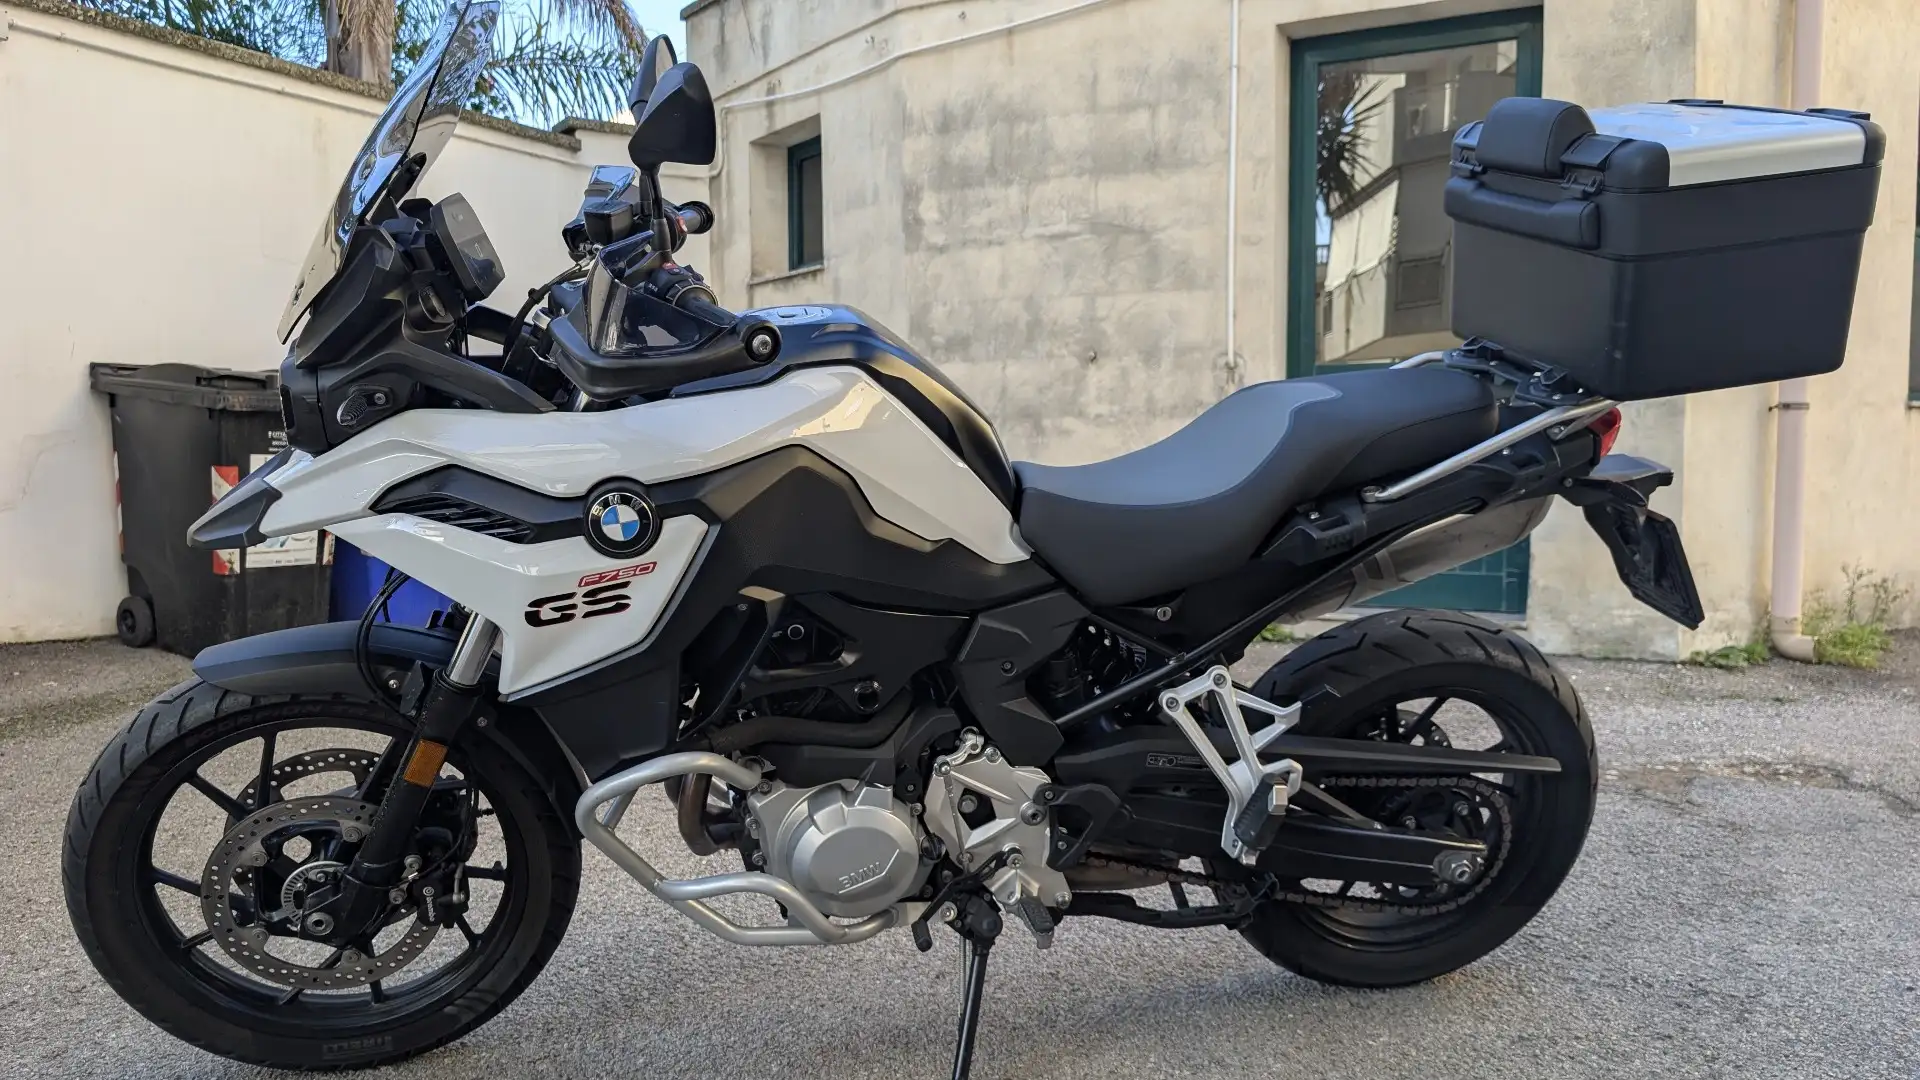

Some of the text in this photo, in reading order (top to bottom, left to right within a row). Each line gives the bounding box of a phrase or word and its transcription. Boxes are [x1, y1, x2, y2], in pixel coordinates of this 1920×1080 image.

[592, 495, 643, 517] BMW
[580, 562, 655, 587] F750
[524, 581, 632, 628] GS
[838, 861, 881, 891] BMW
